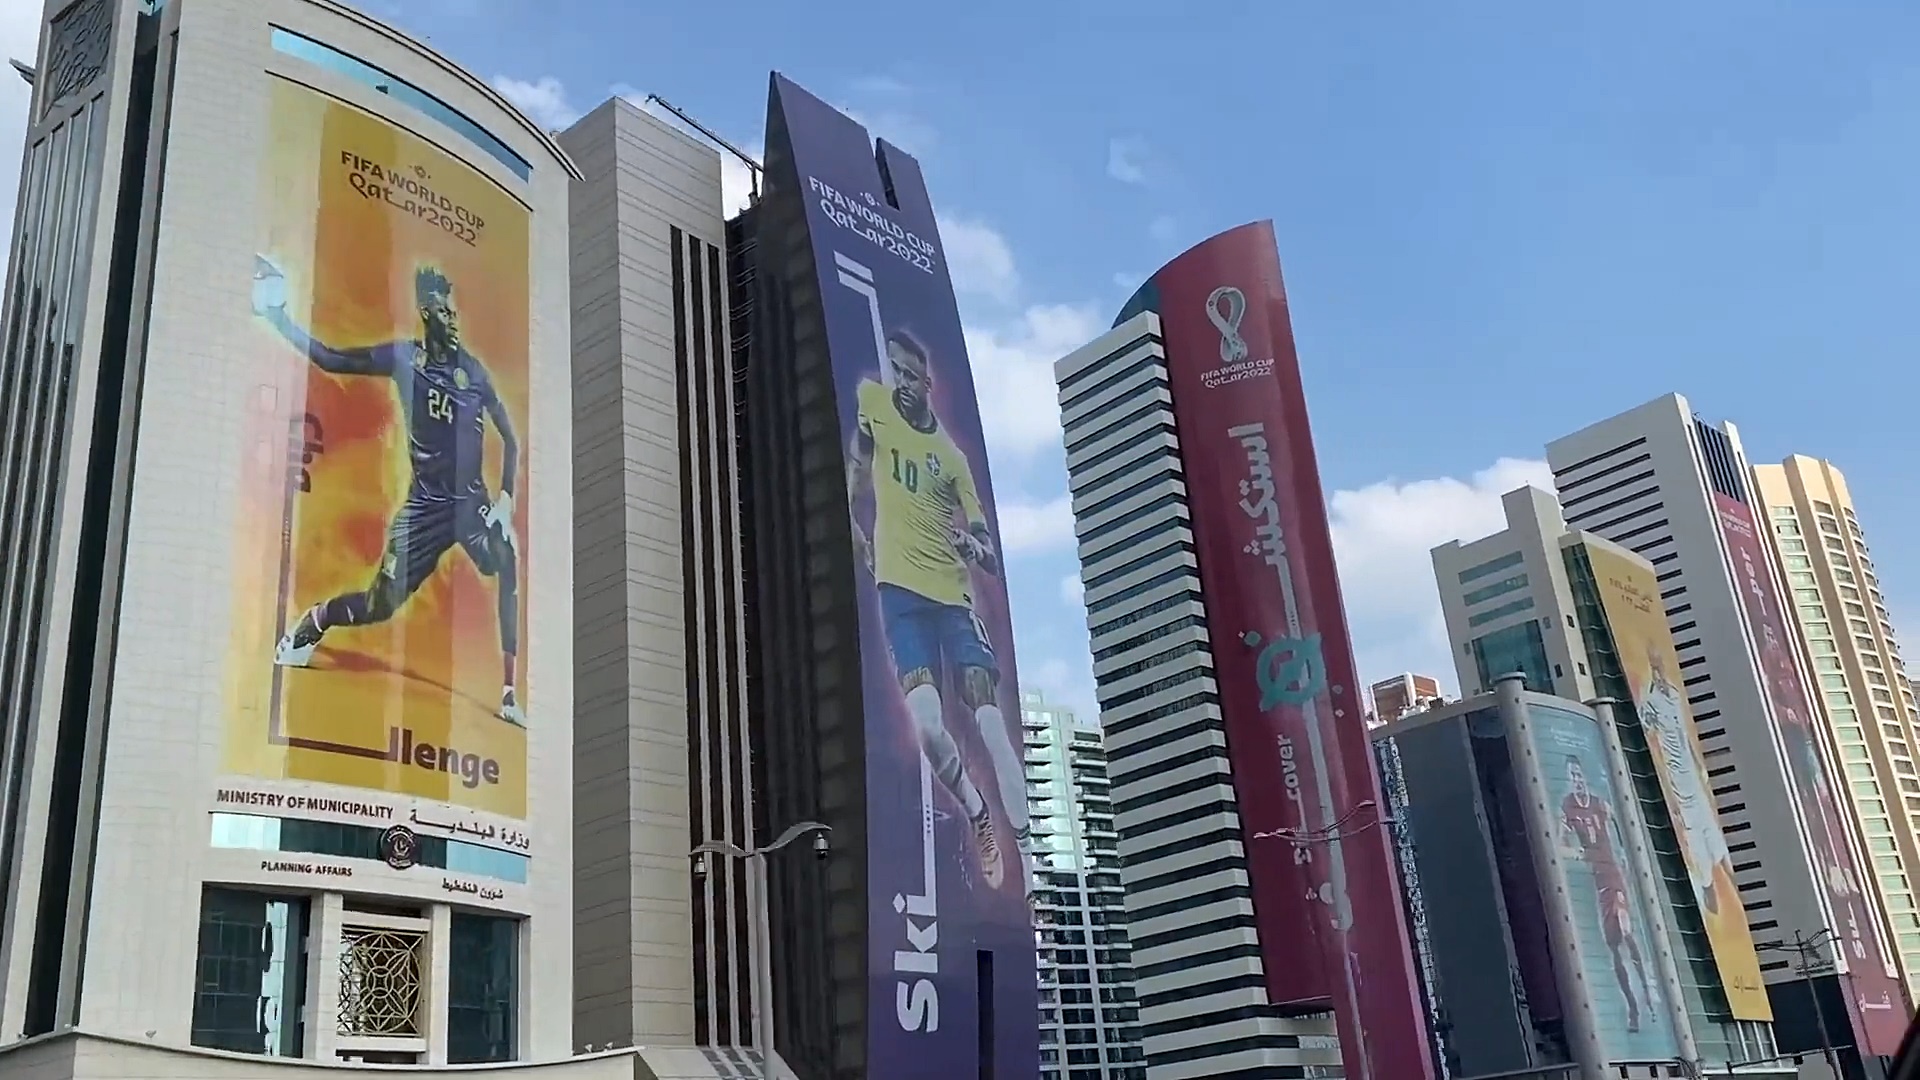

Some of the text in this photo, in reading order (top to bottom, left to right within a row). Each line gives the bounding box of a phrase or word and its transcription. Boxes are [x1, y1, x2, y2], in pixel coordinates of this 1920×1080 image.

[341, 150, 485, 230] FIFA WORLD CUP
[808, 175, 935, 256] FIFA WORLD CUP
[1200, 358, 1275, 381] FIFA WORLD CUP
[427, 387, 453, 424] 24
[891, 447, 918, 494] 10
[217, 789, 394, 819] MINISTRY OF MUNICIPALITY
[261, 860, 353, 877] PLANNING AFFAIRS
